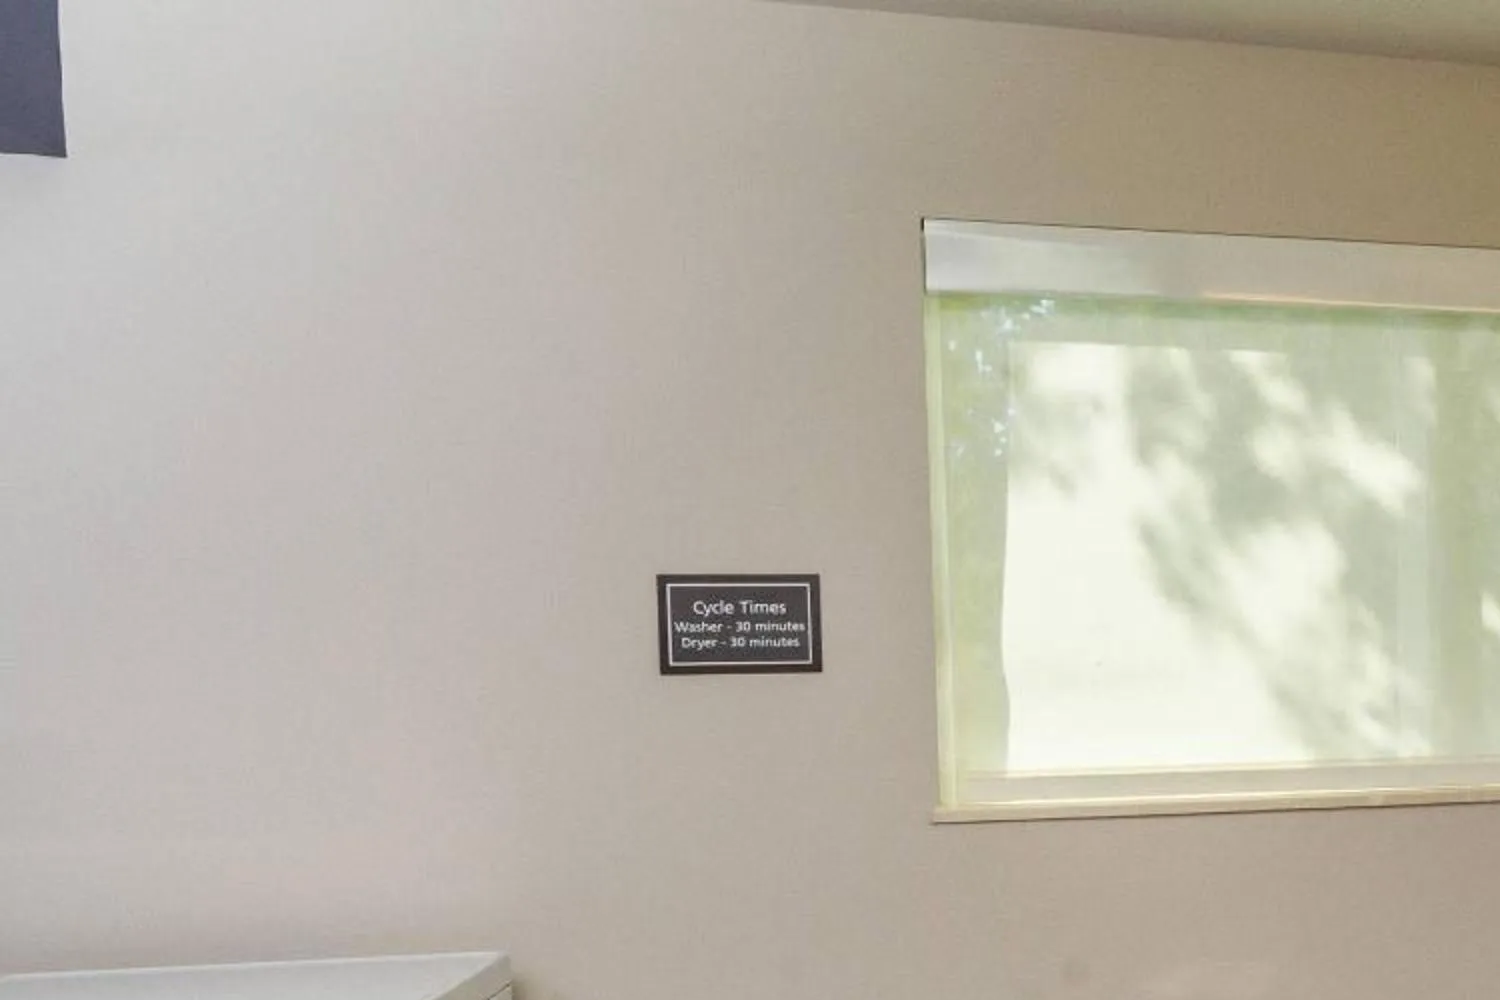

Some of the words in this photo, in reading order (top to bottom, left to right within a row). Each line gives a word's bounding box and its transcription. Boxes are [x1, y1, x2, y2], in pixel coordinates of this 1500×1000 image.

[693, 600, 735, 617] Cycle
[740, 600, 787, 615] Times
[674, 621, 723, 633] Washer
[735, 621, 751, 632] 30
[755, 620, 806, 632] minutes
[681, 637, 718, 650] Dryer
[729, 636, 746, 648] 30
[749, 636, 800, 648] minutes
